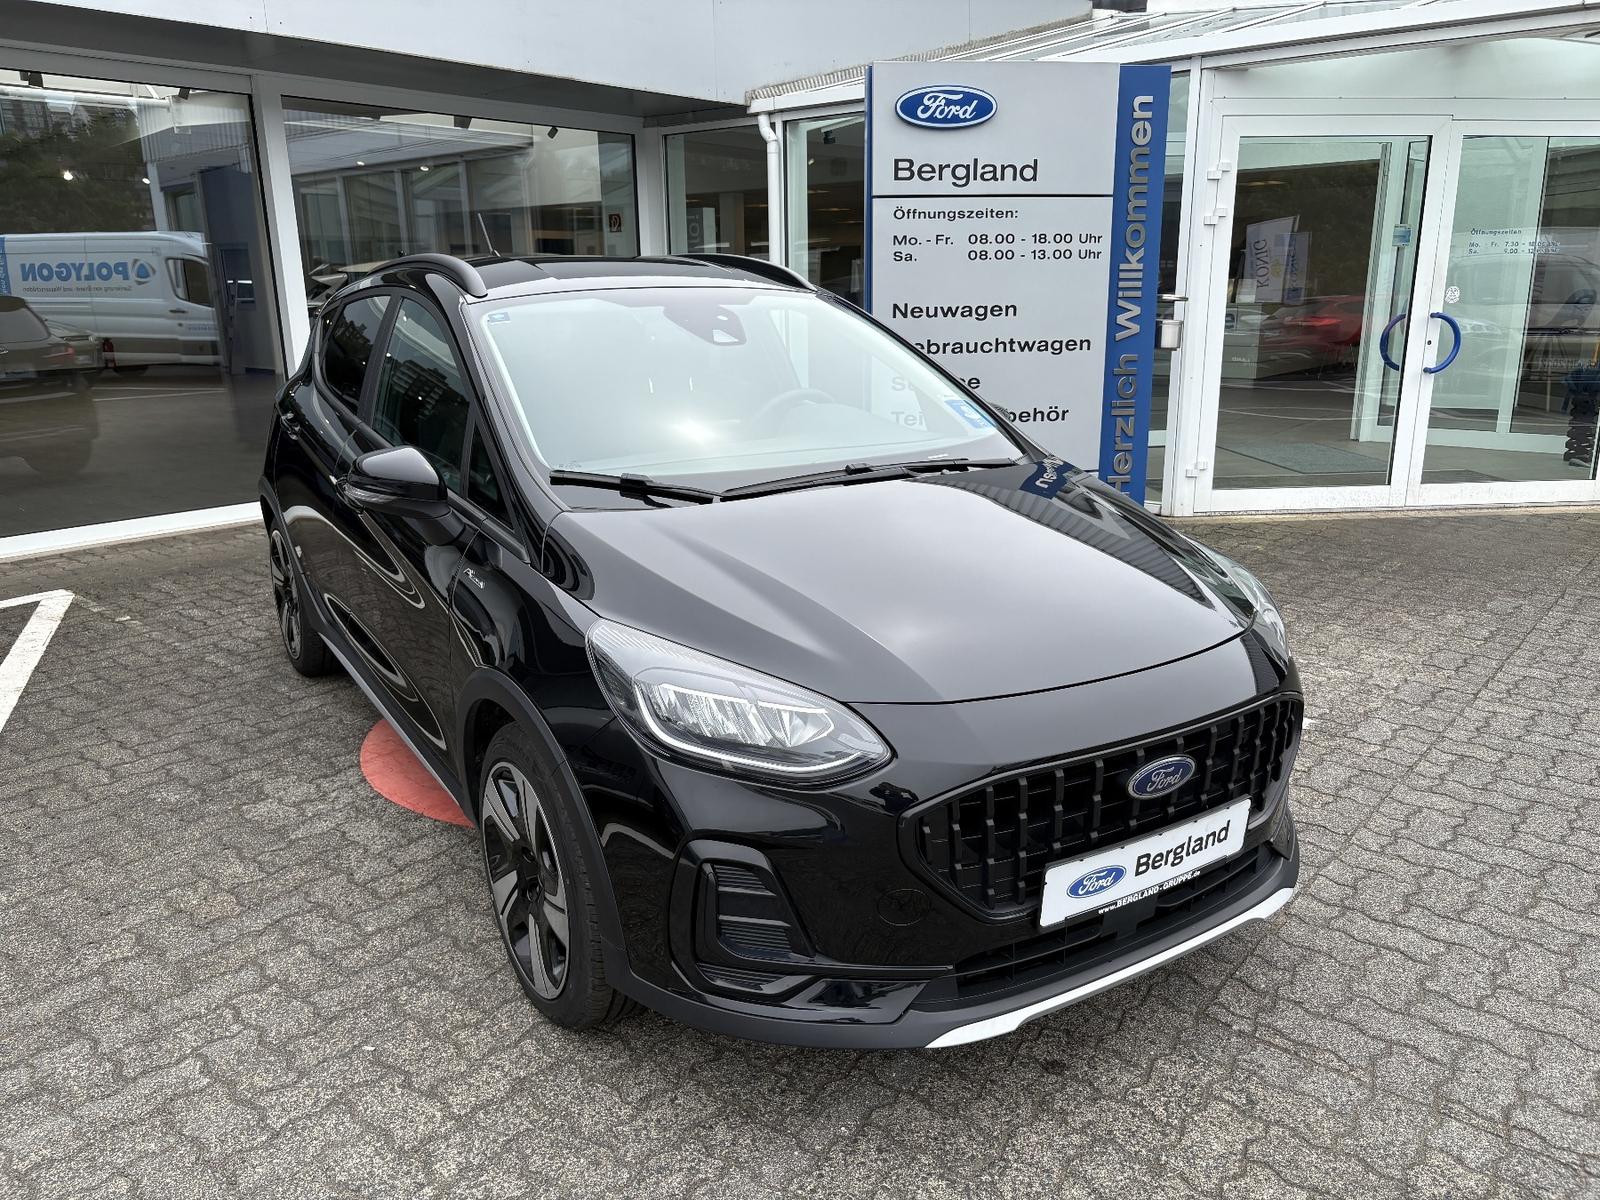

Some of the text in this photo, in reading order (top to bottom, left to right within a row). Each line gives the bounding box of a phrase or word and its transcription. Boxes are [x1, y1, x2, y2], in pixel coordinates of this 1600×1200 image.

[916, 92, 979, 119] Ford
[893, 157, 1038, 188] Bergland
[893, 206, 1018, 222] Öffnungszeiten:
[893, 234, 922, 246] Mo.
[935, 234, 954, 246] Fr.
[968, 233, 1015, 245] 08.00
[1031, 233, 1073, 244] 18.00
[1078, 233, 1103, 244] Uhr
[893, 251, 917, 262] Sa.
[967, 249, 1015, 261] 08.00
[1030, 249, 1073, 260] 13.00
[1078, 249, 1102, 260] Uhr
[1107, 94, 1154, 497] Herzlich Willkommen
[892, 302, 1017, 321] Neuwagen
[914, 338, 1091, 355] ebrauchtwagen
[1008, 406, 1069, 423] behör
[1146, 768, 1183, 792] Ford
[1077, 819, 1231, 894] Ford Bergland
